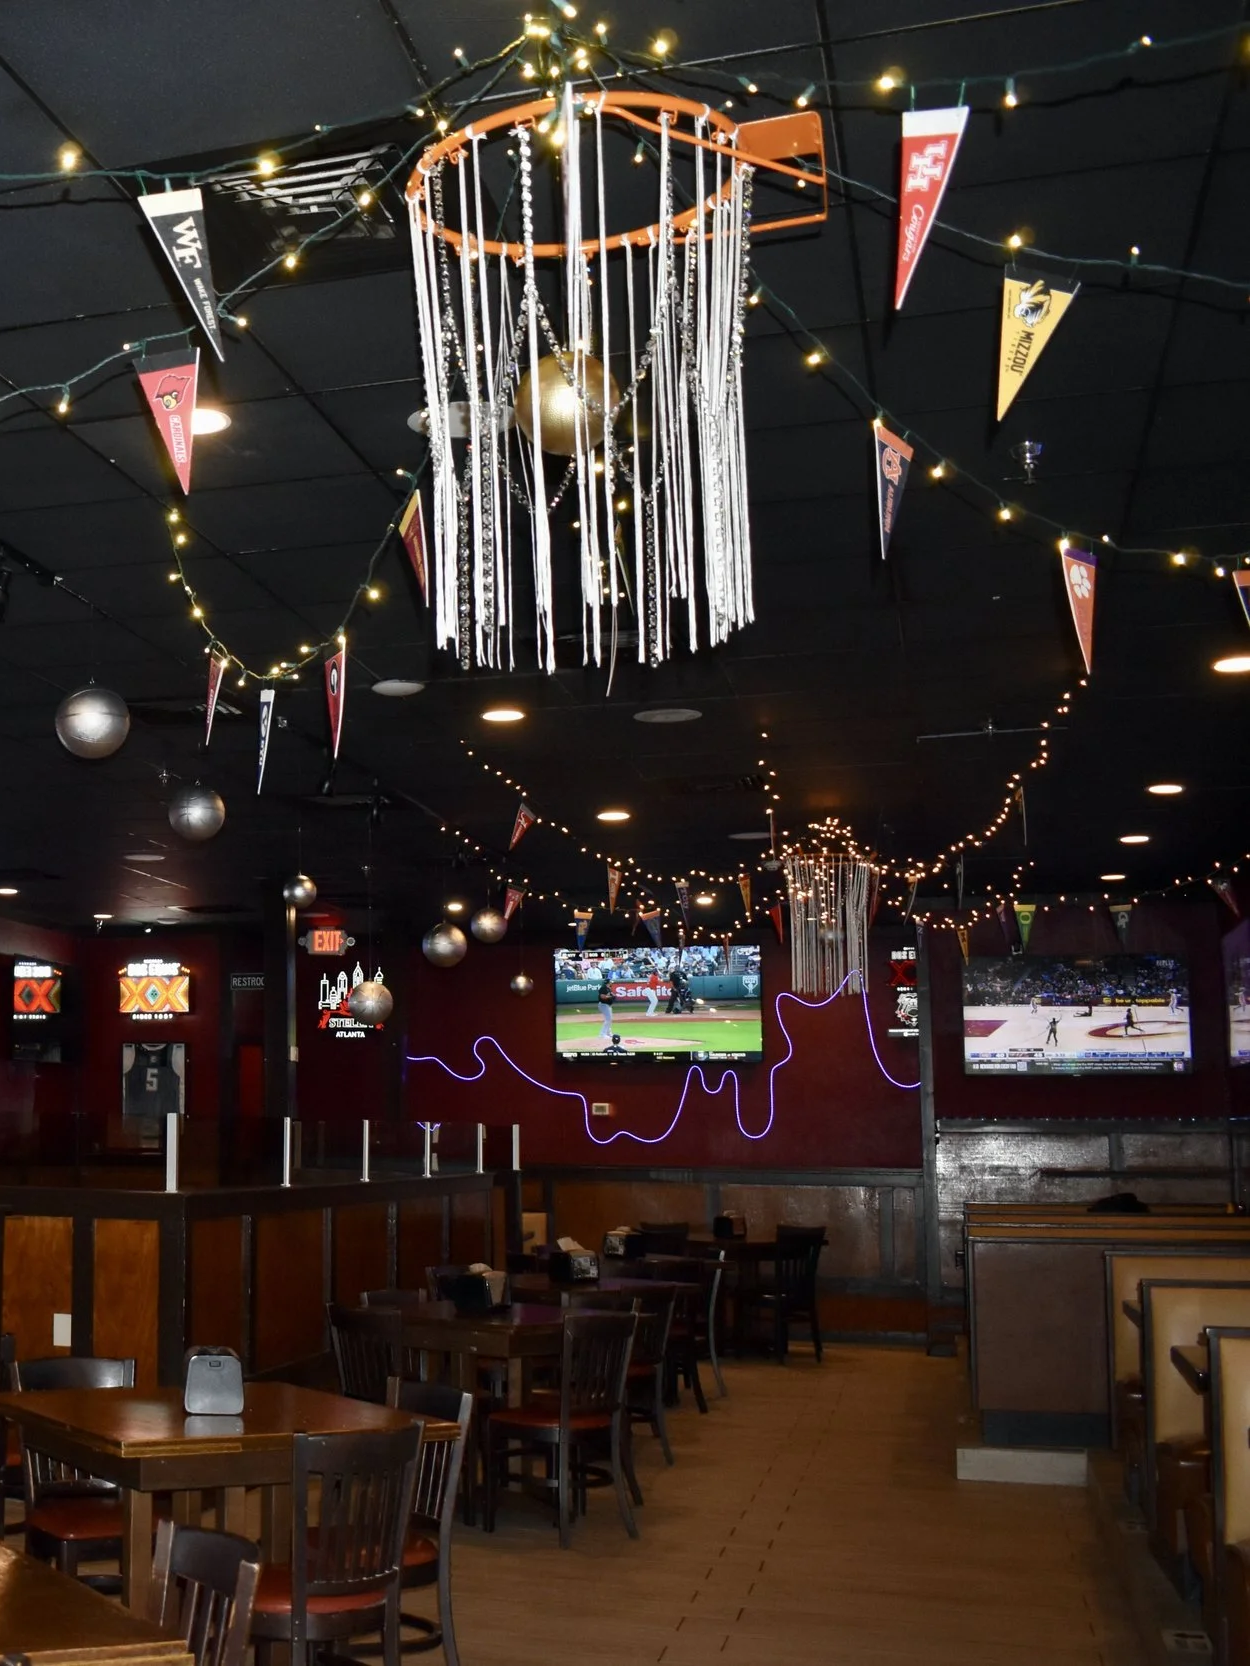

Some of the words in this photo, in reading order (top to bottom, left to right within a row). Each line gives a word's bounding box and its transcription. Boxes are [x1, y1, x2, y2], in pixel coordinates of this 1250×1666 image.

[901, 203, 925, 262] Cougars
[201, 299, 216, 330] FOREST
[1010, 330, 1034, 373] MIZZOU
[169, 414, 187, 464] CARDINALS
[314, 930, 342, 952] EXIT
[566, 984, 587, 993] jetBlue
[145, 1067, 159, 1092] 5
